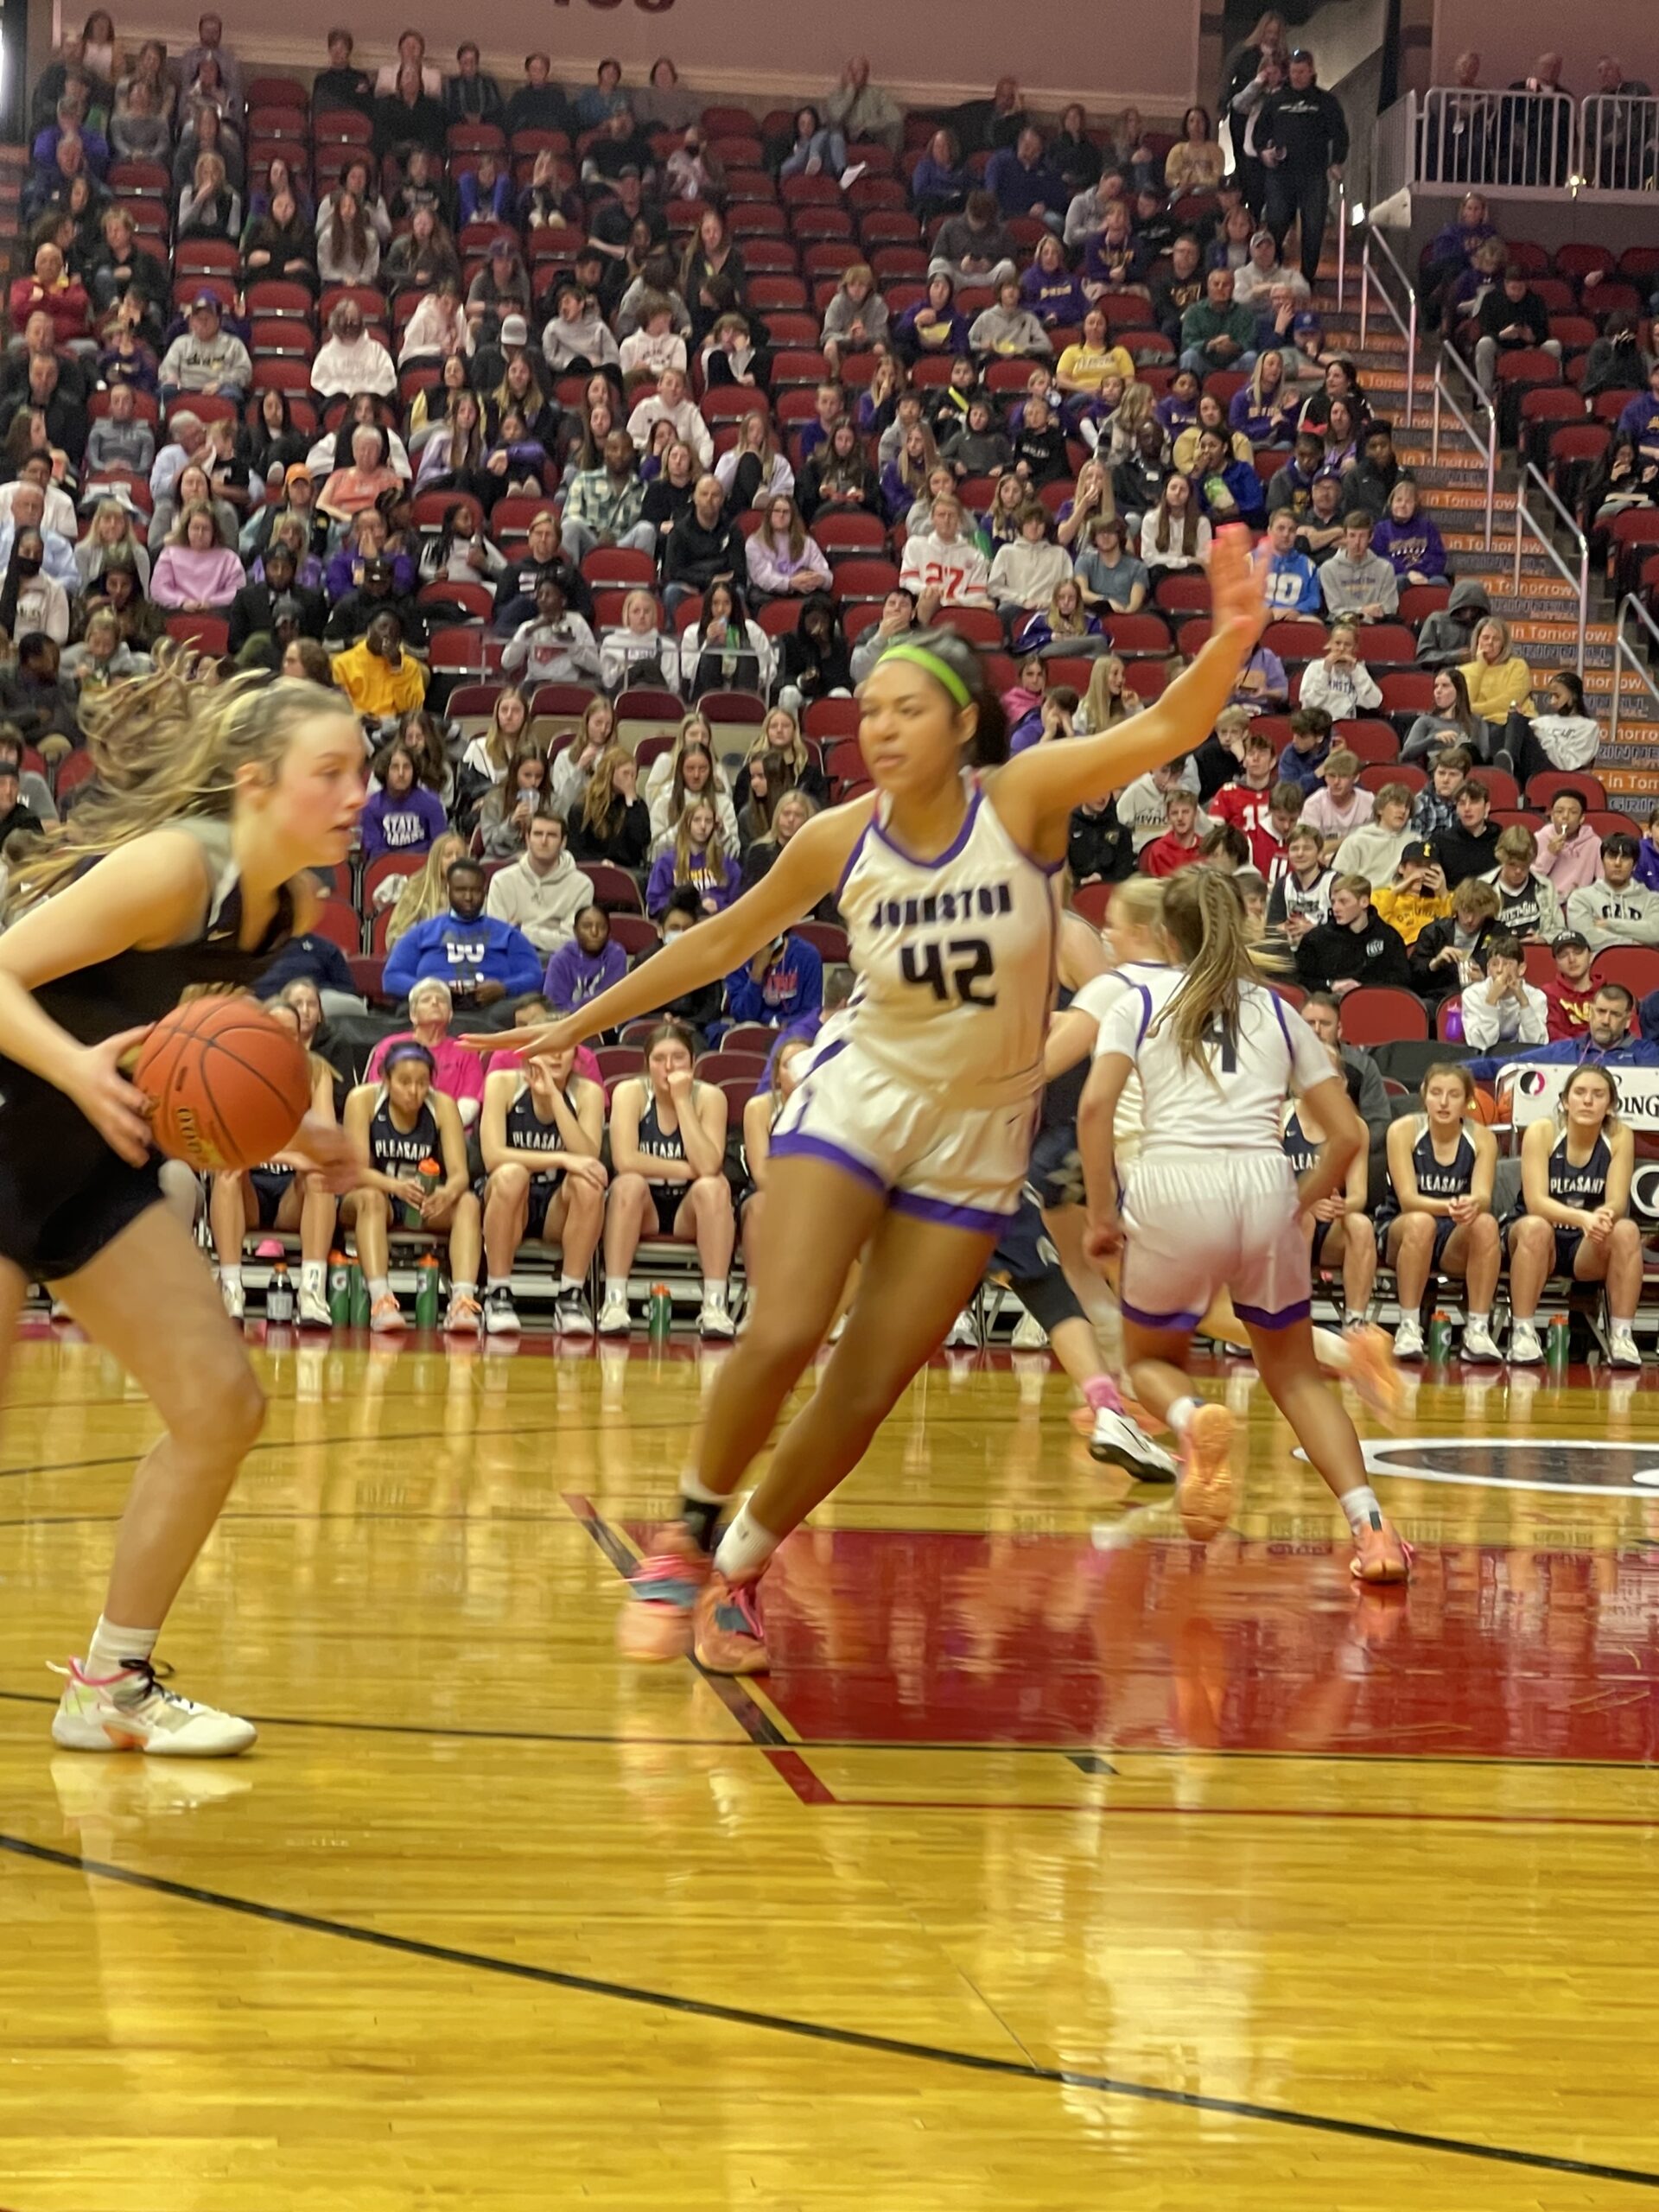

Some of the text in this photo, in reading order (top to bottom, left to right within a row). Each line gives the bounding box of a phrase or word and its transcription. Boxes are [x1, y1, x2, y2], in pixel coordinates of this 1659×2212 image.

[1608, 772, 1623, 789] in
[870, 884, 1012, 927] JOHNSTON
[900, 939, 997, 1007] 42
[1201, 1005, 1239, 1073] 4
[1549, 1174, 1605, 1195] PLEASANT
